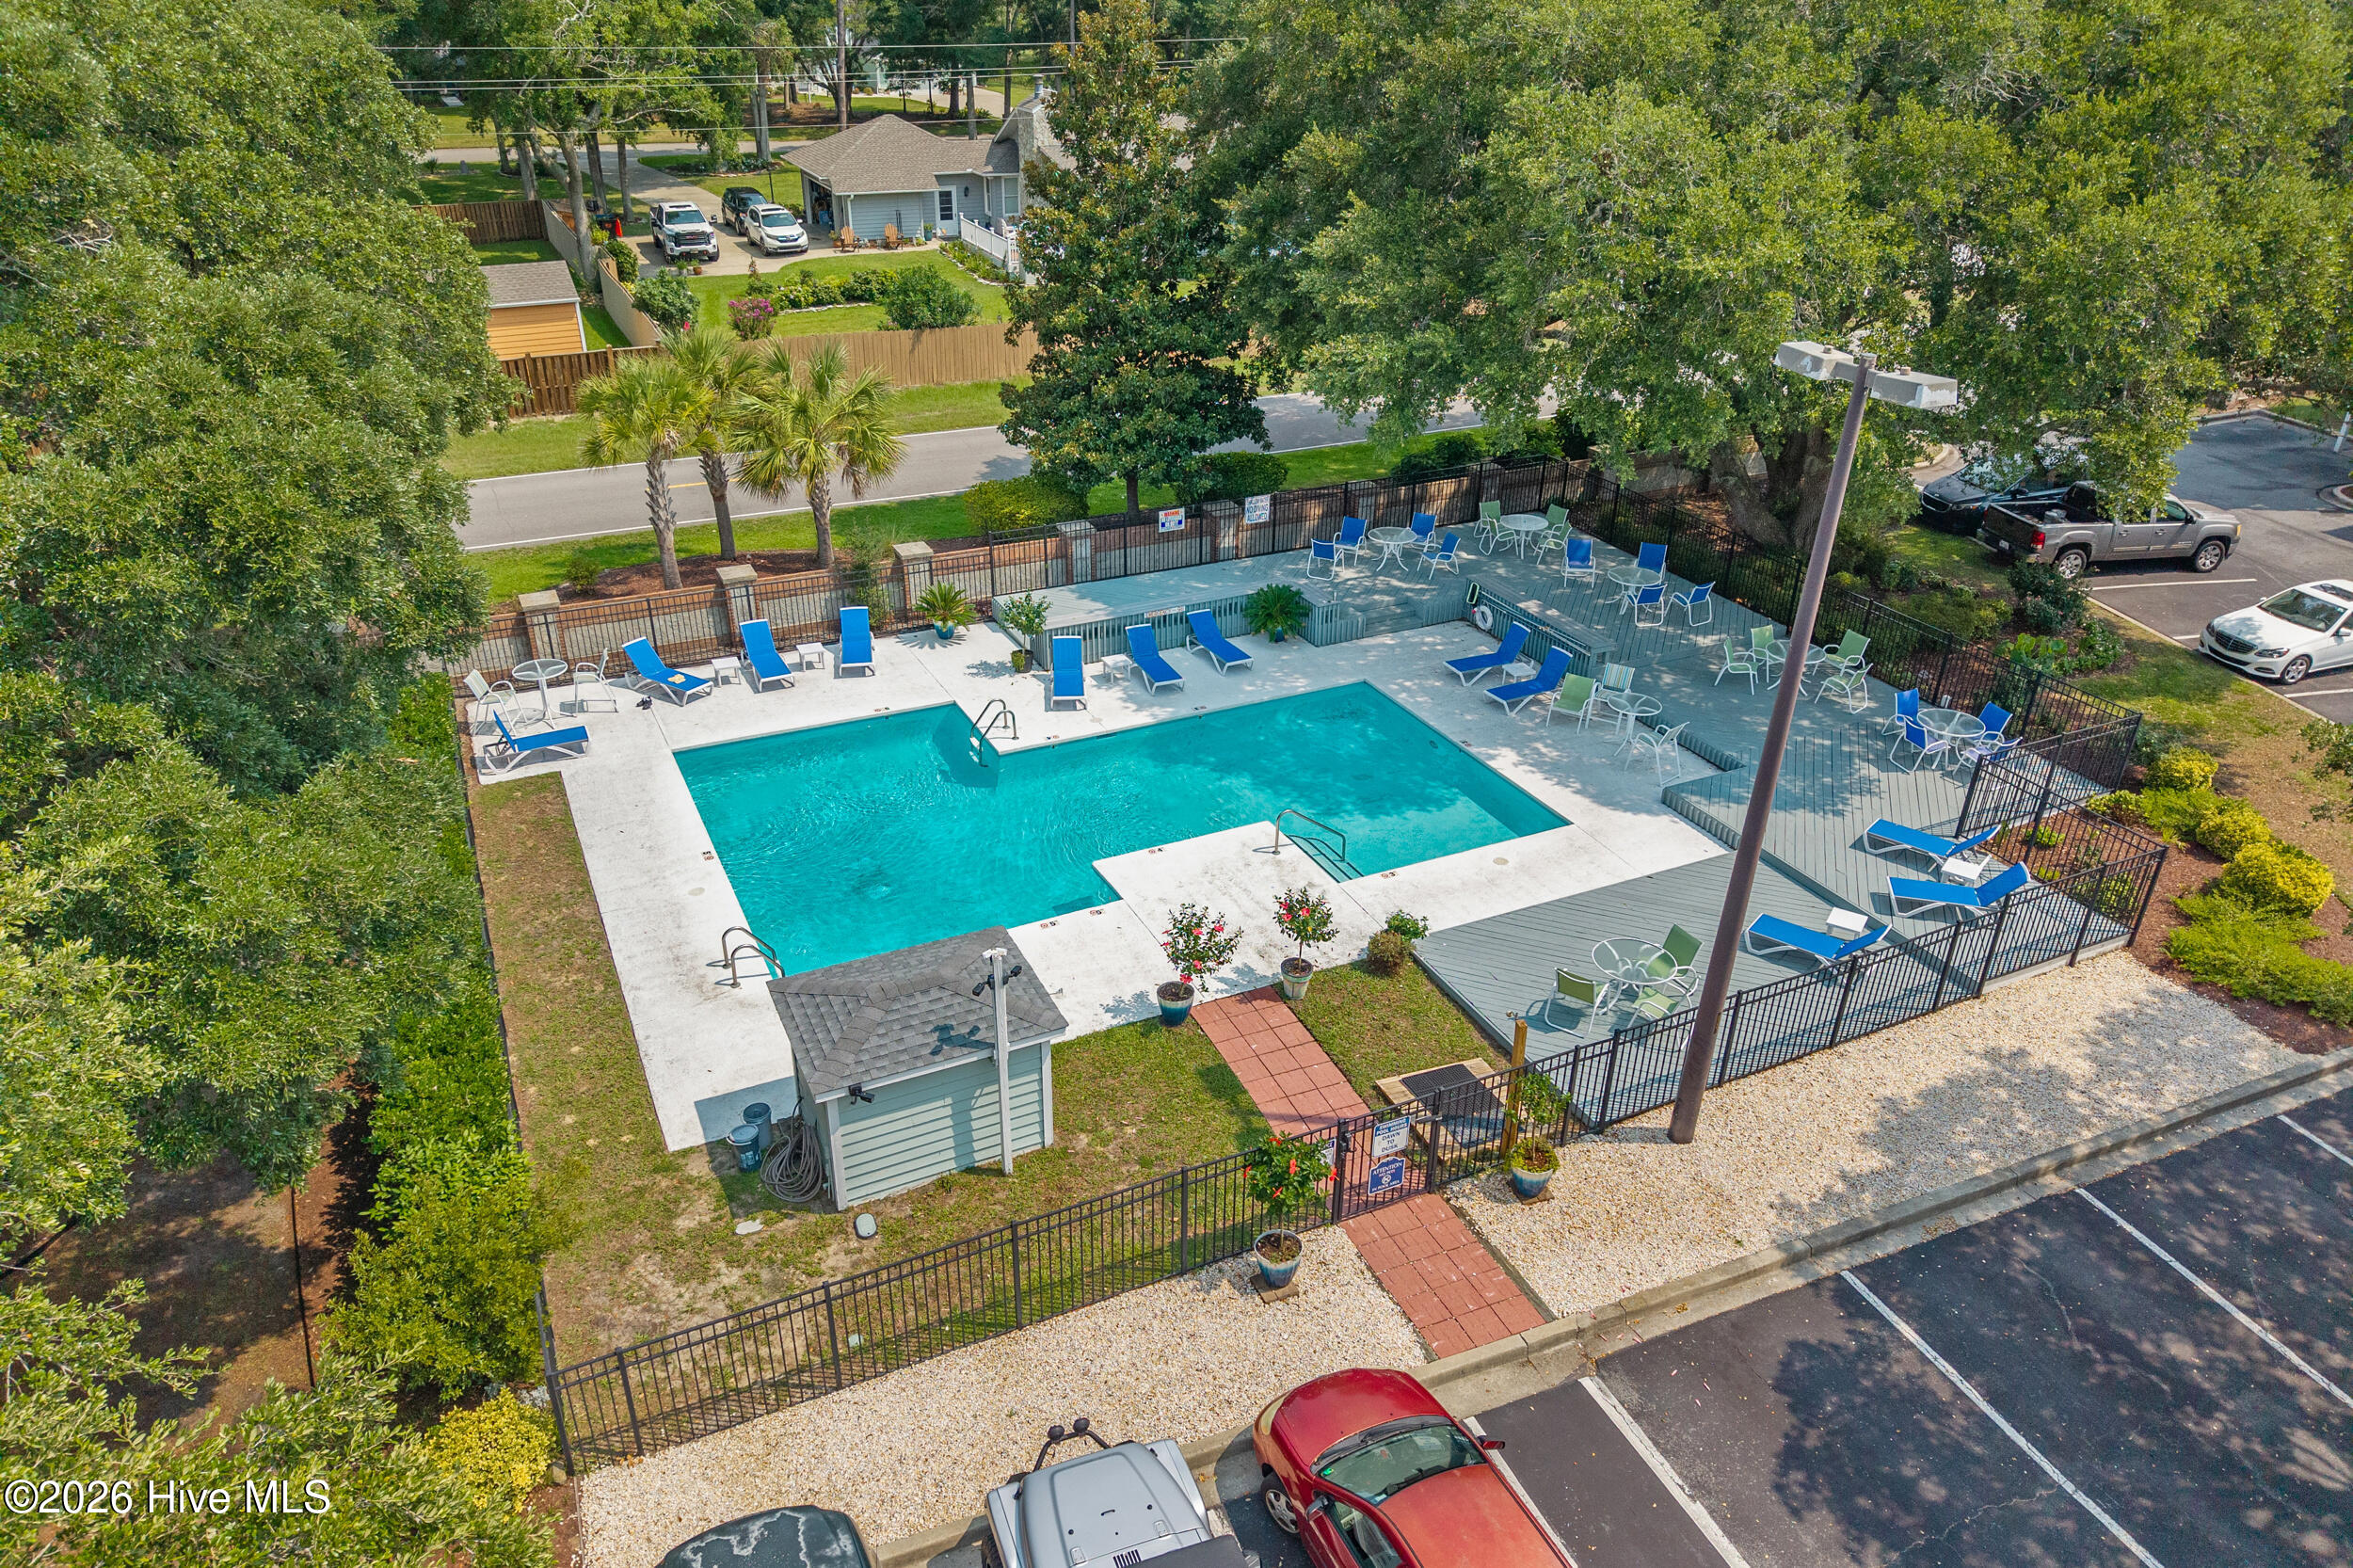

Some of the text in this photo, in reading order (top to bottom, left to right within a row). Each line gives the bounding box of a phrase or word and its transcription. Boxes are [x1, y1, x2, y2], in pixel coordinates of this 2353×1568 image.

[1390, 1124, 1408, 1132] HOURS
[1382, 1131, 1401, 1141] DAWN
[1382, 1144, 1398, 1153] DUSK
[1373, 1161, 1402, 1176] ATTENTION
